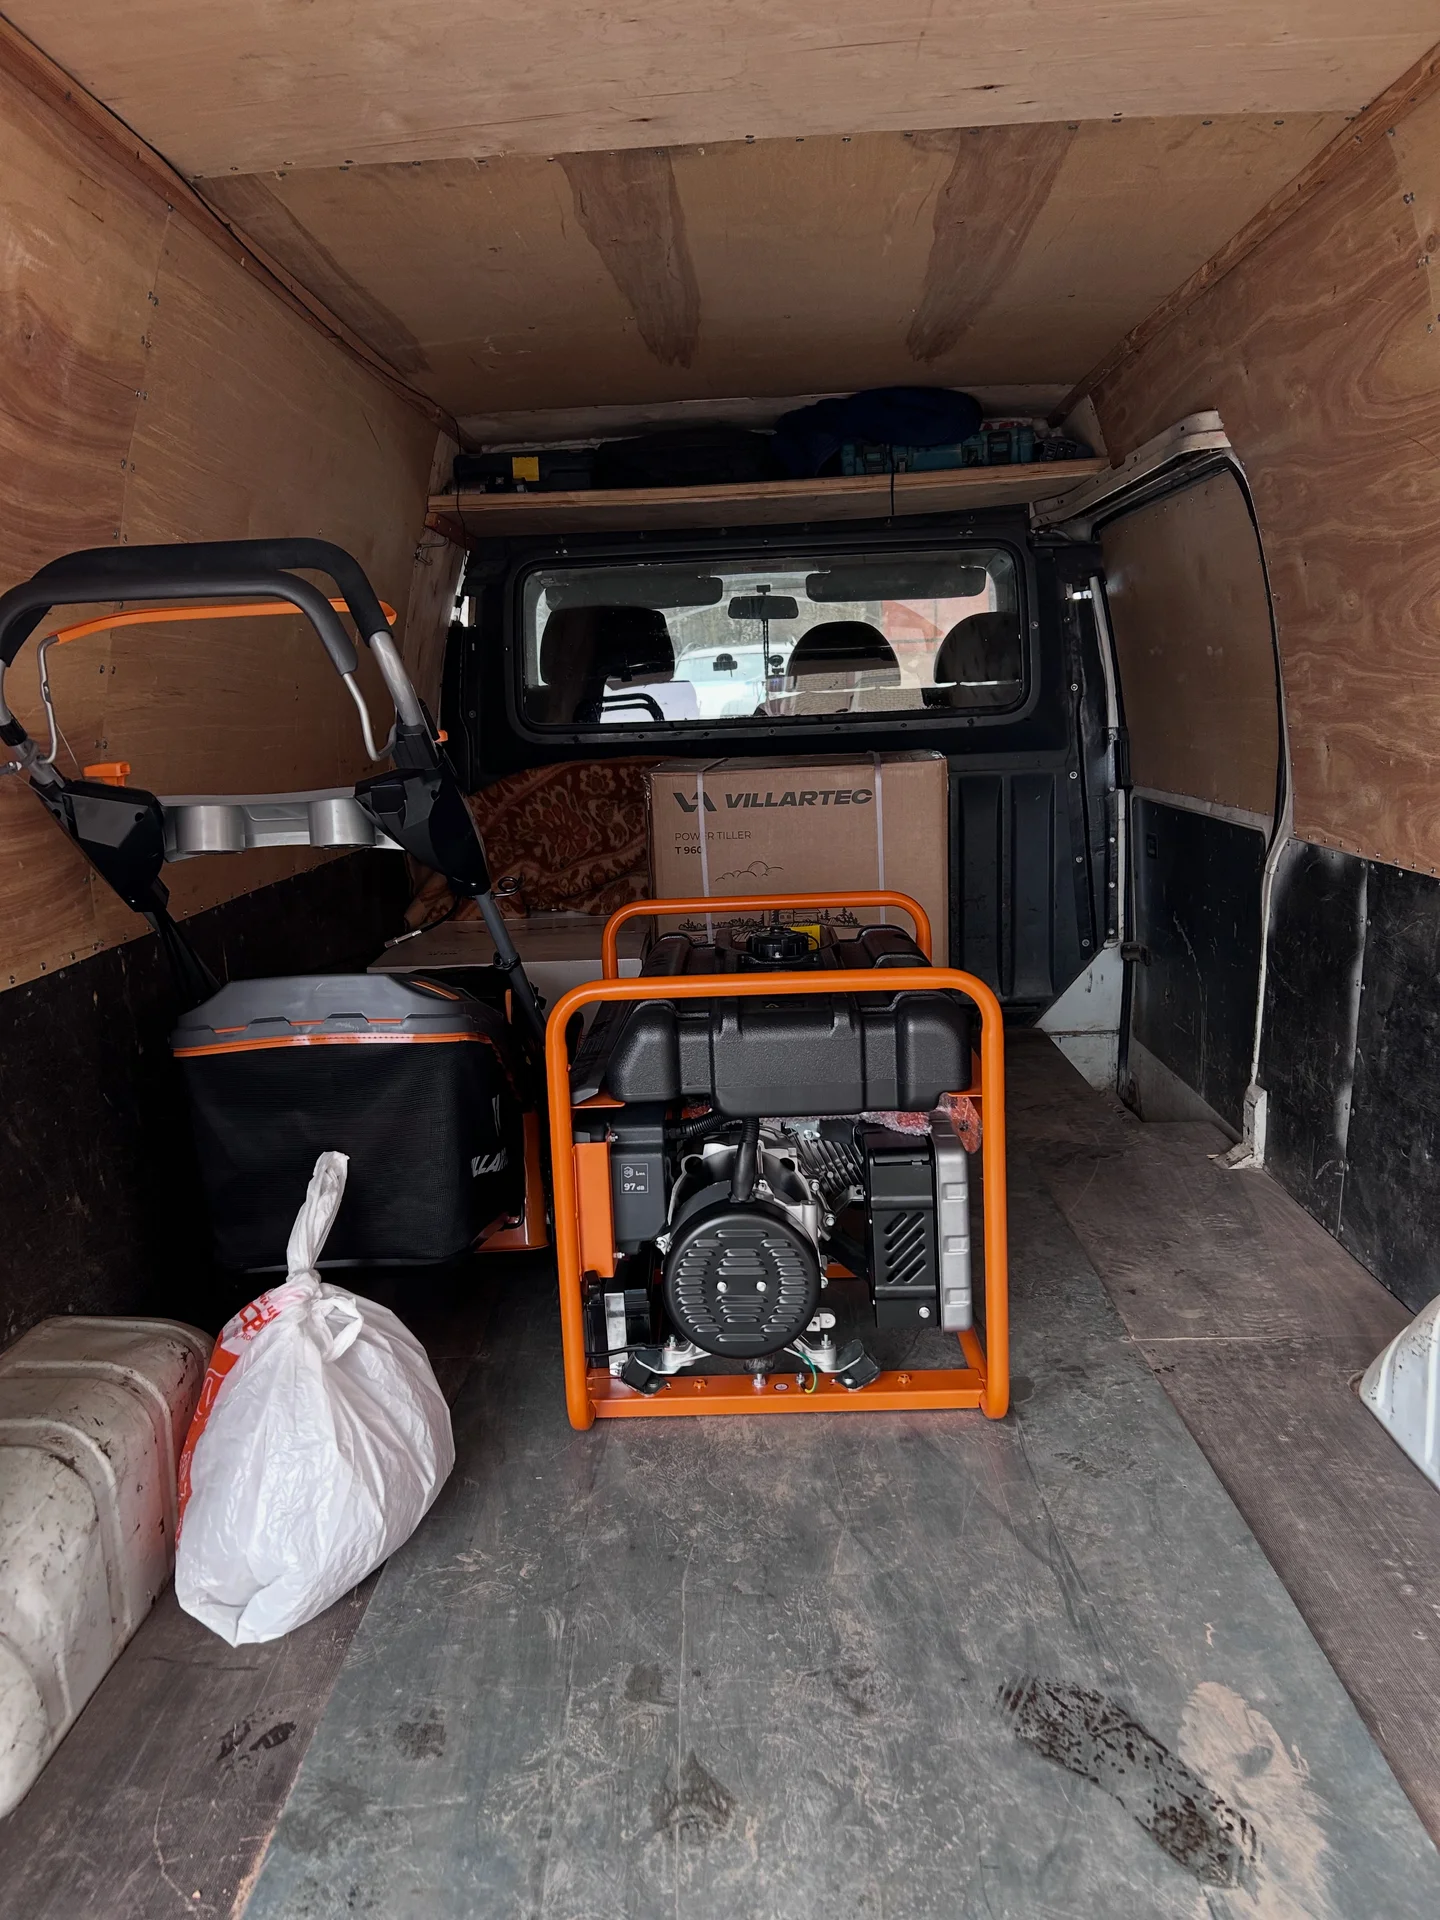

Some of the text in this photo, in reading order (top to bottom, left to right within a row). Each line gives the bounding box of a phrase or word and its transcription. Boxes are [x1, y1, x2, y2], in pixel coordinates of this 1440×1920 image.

[725, 788, 873, 809] VILLARTEC
[716, 830, 752, 840] TILLER
[675, 846, 681, 854] T
[623, 1182, 636, 1191] 97
